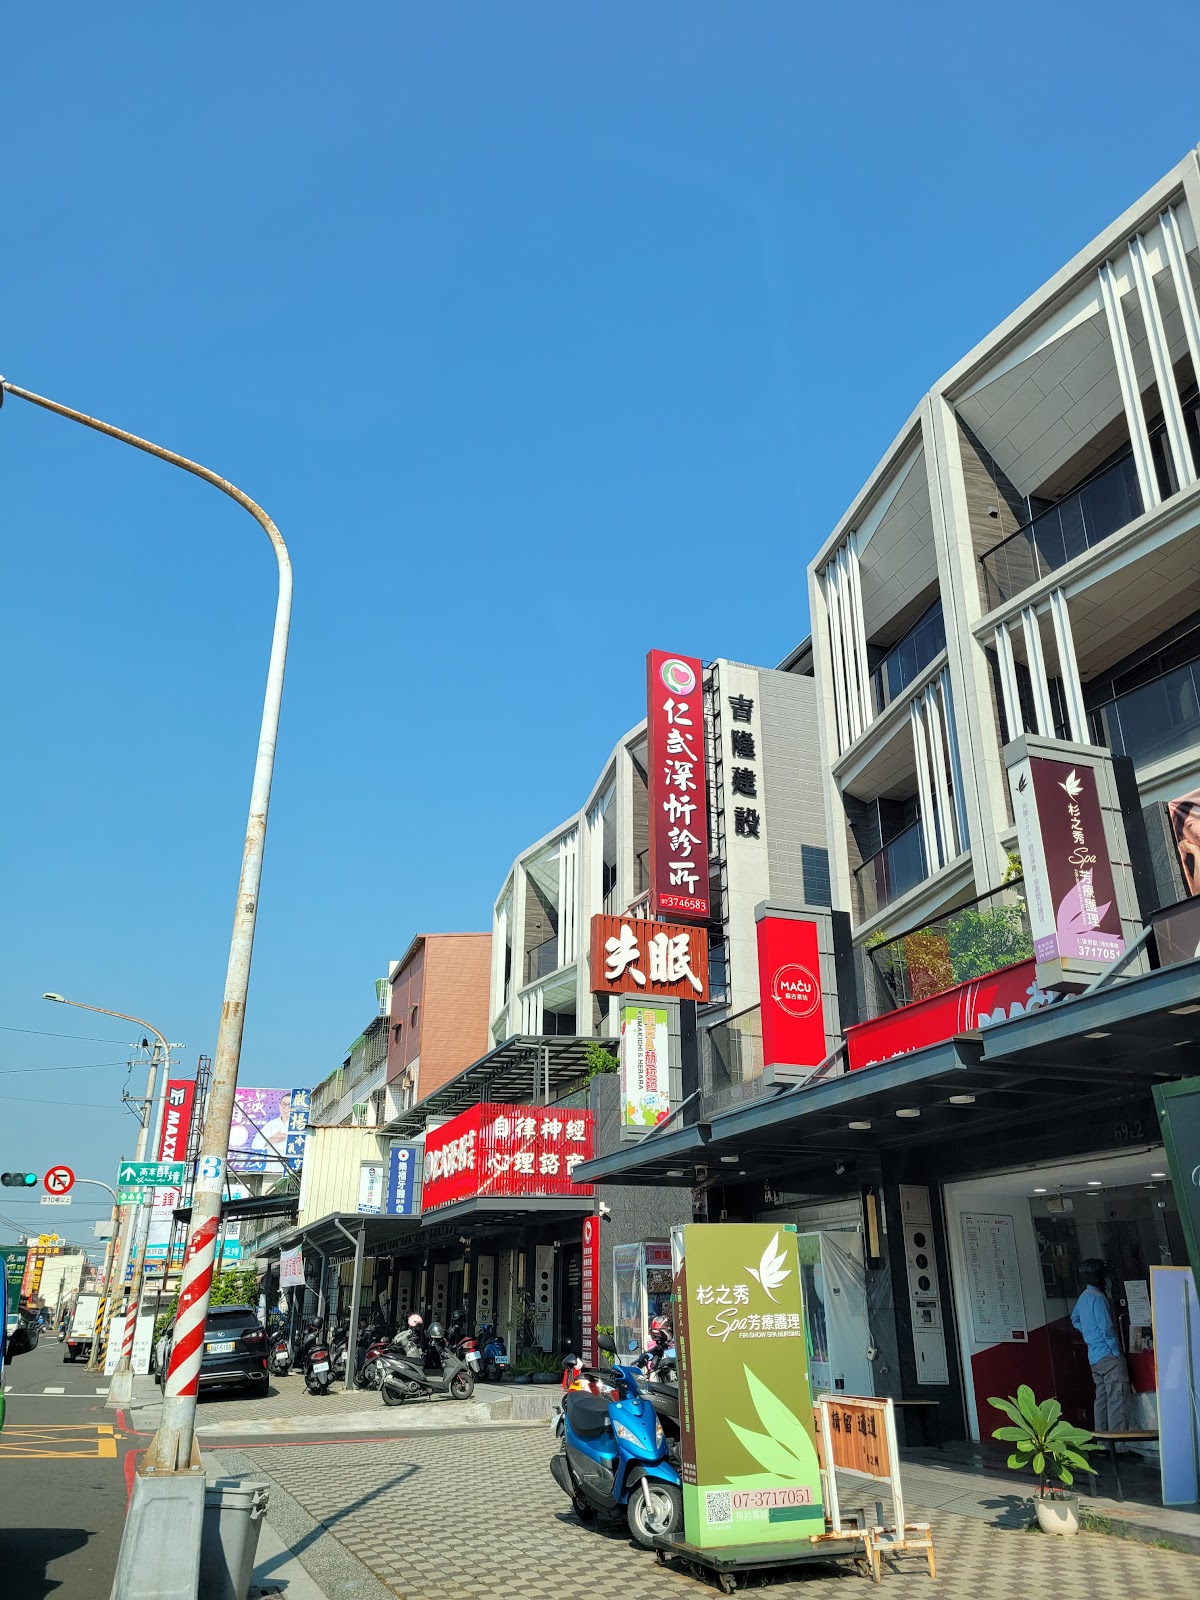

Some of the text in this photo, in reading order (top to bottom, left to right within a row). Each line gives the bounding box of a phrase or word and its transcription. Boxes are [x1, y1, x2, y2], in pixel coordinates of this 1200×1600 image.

[727, 694, 760, 840] 吉隆建設
[662, 696, 702, 895] 仁武深忻診所
[1067, 802, 1085, 845] 杉之秀
[1068, 847, 1097, 870] Spa
[604, 923, 704, 994] 失眠
[493, 1115, 587, 1142] 自律神經
[696, 1284, 750, 1305] 杉之秀
[706, 1307, 801, 1343] Spa 芳療護理
[733, 1488, 812, 1509] 07-3717051
